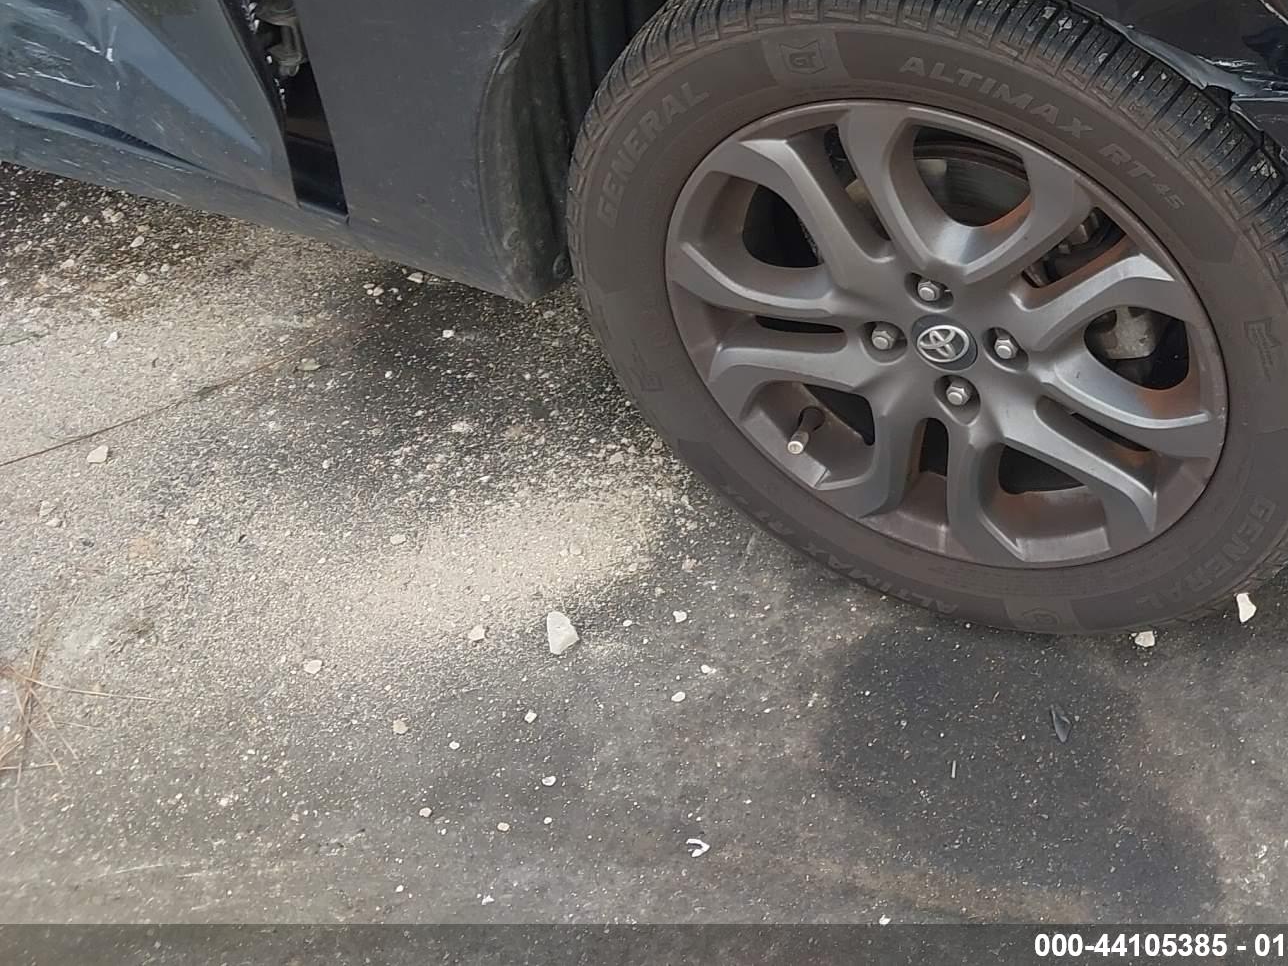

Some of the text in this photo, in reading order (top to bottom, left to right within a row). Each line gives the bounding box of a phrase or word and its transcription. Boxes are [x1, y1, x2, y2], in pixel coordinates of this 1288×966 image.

[899, 56, 1094, 139] ALTIMAX
[596, 81, 711, 229] GENERAL
[1136, 497, 1276, 610] GENERAL
